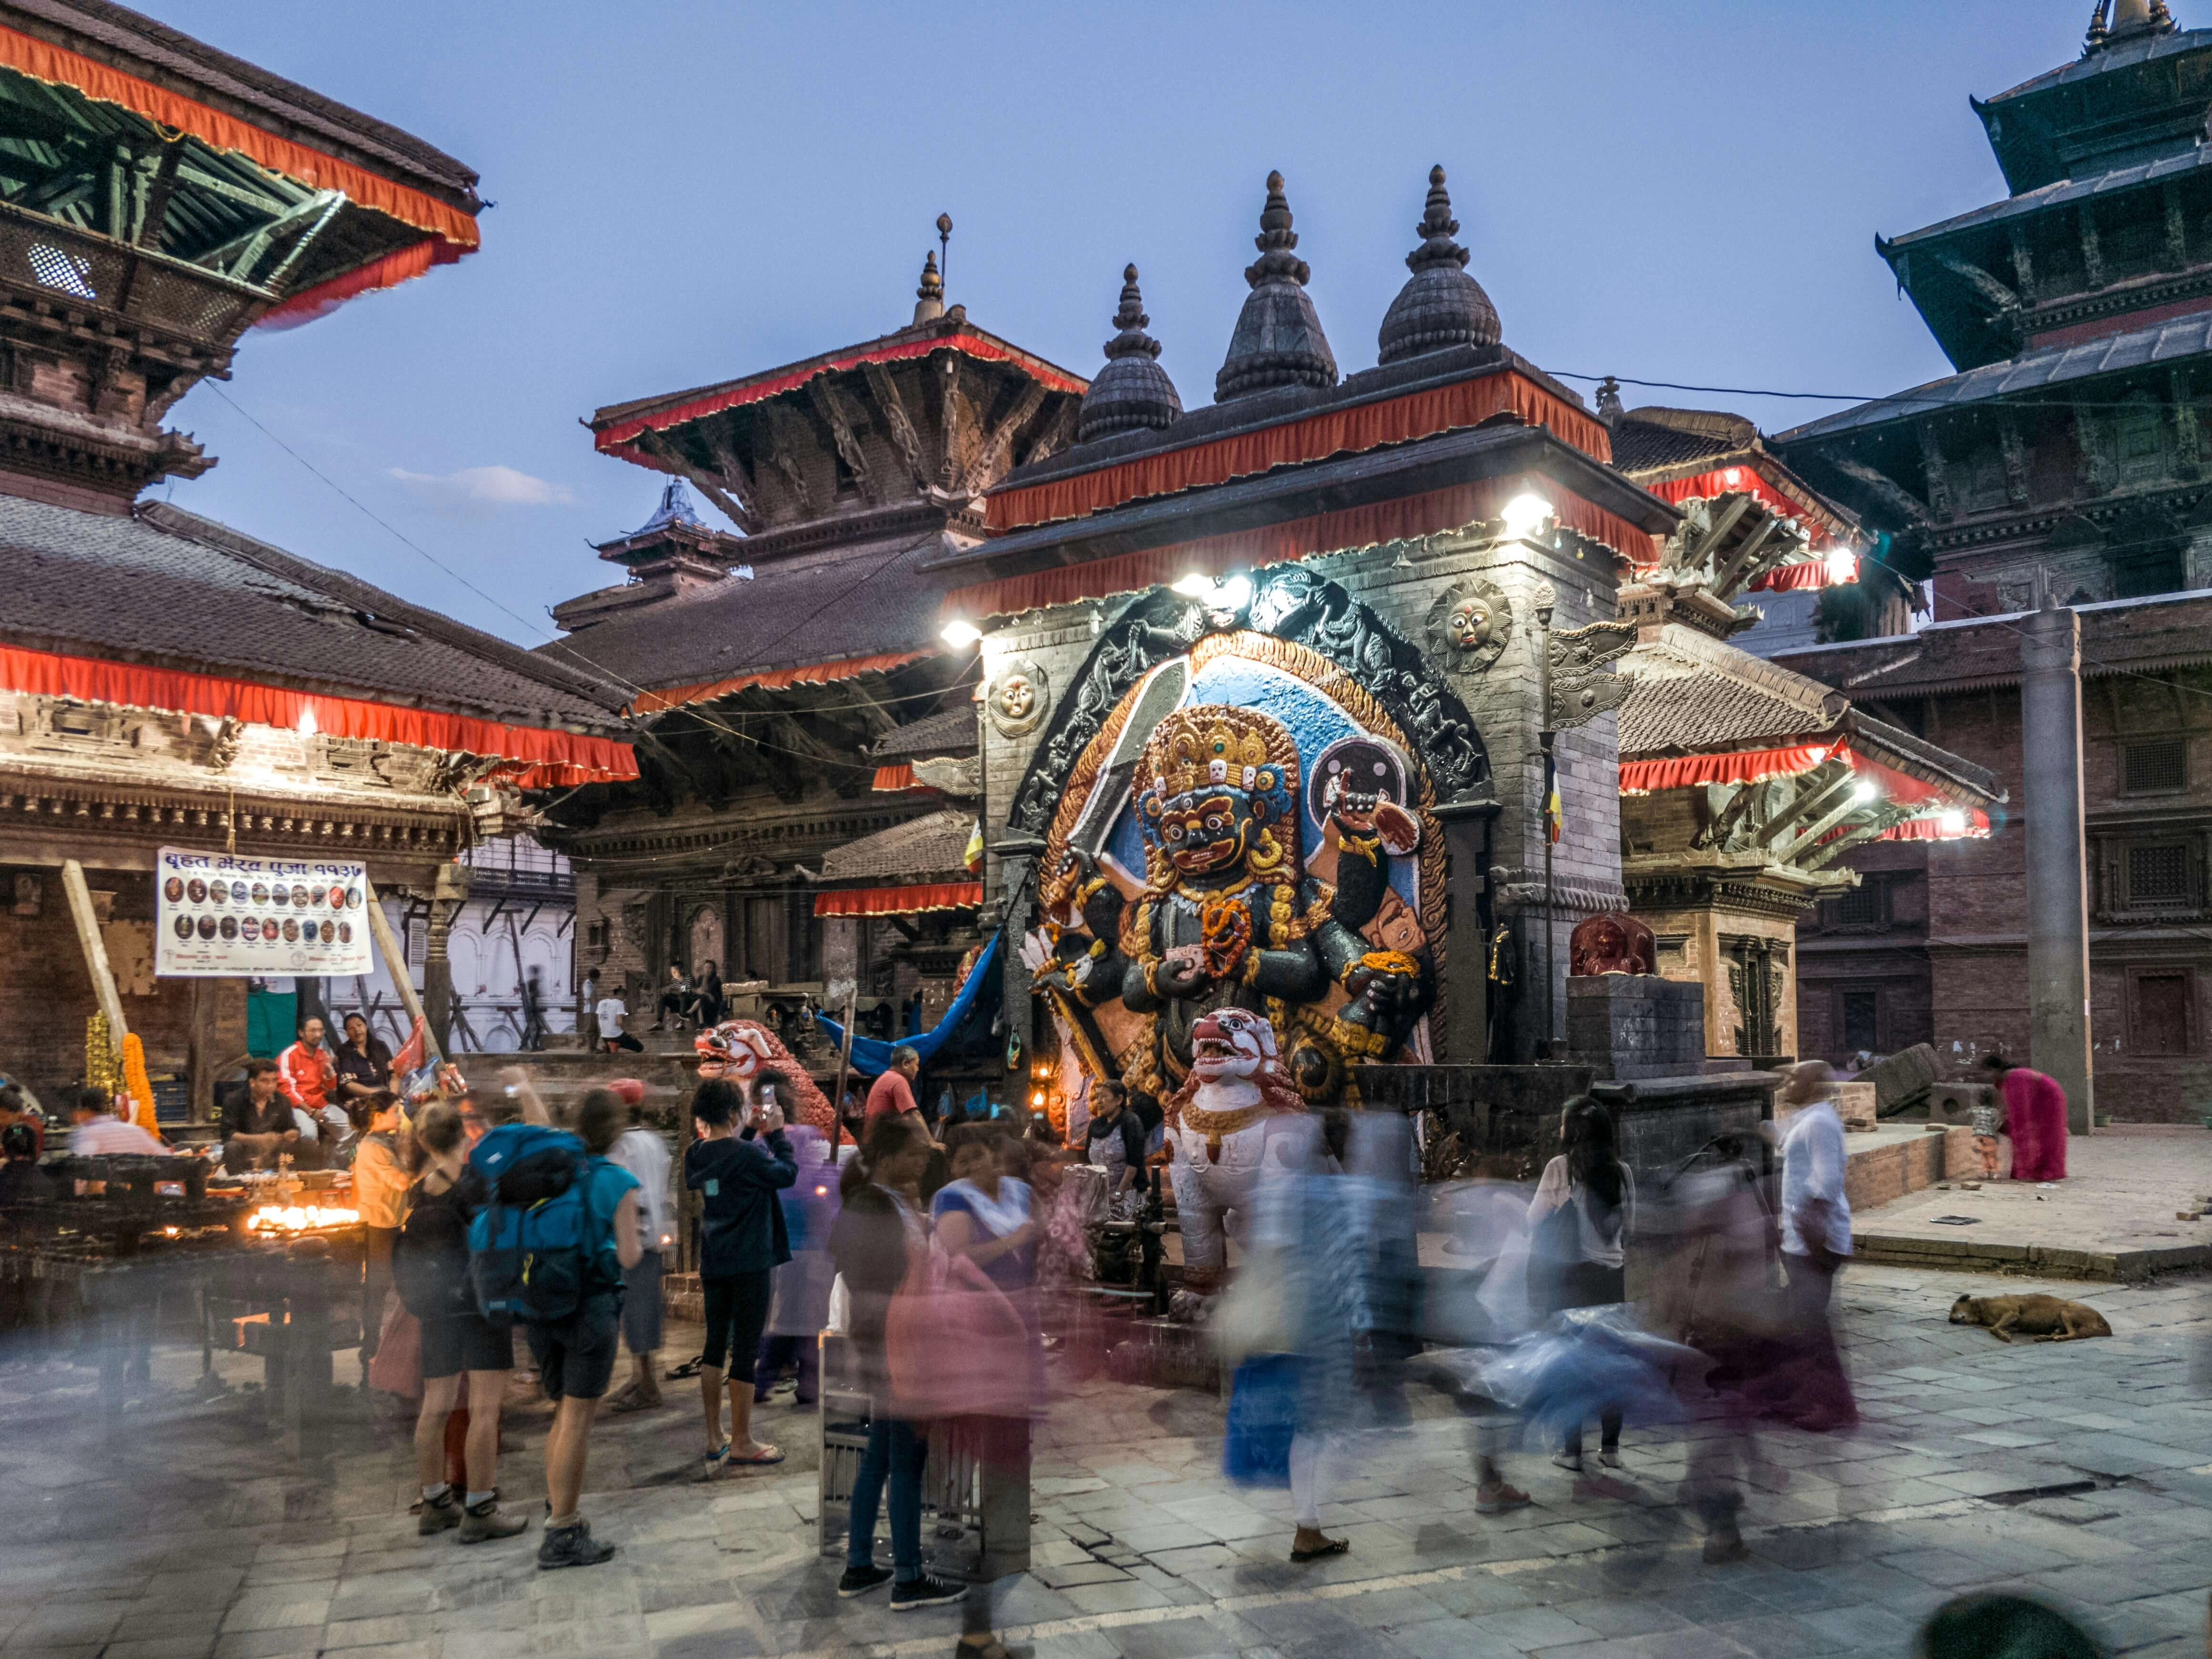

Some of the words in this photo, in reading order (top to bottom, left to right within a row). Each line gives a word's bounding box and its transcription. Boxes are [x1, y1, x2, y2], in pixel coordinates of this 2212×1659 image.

[165, 852, 211, 869] बृहत
[217, 855, 264, 871] भैरव
[269, 862, 308, 877] पुजा
[314, 865, 362, 877] ११३७
